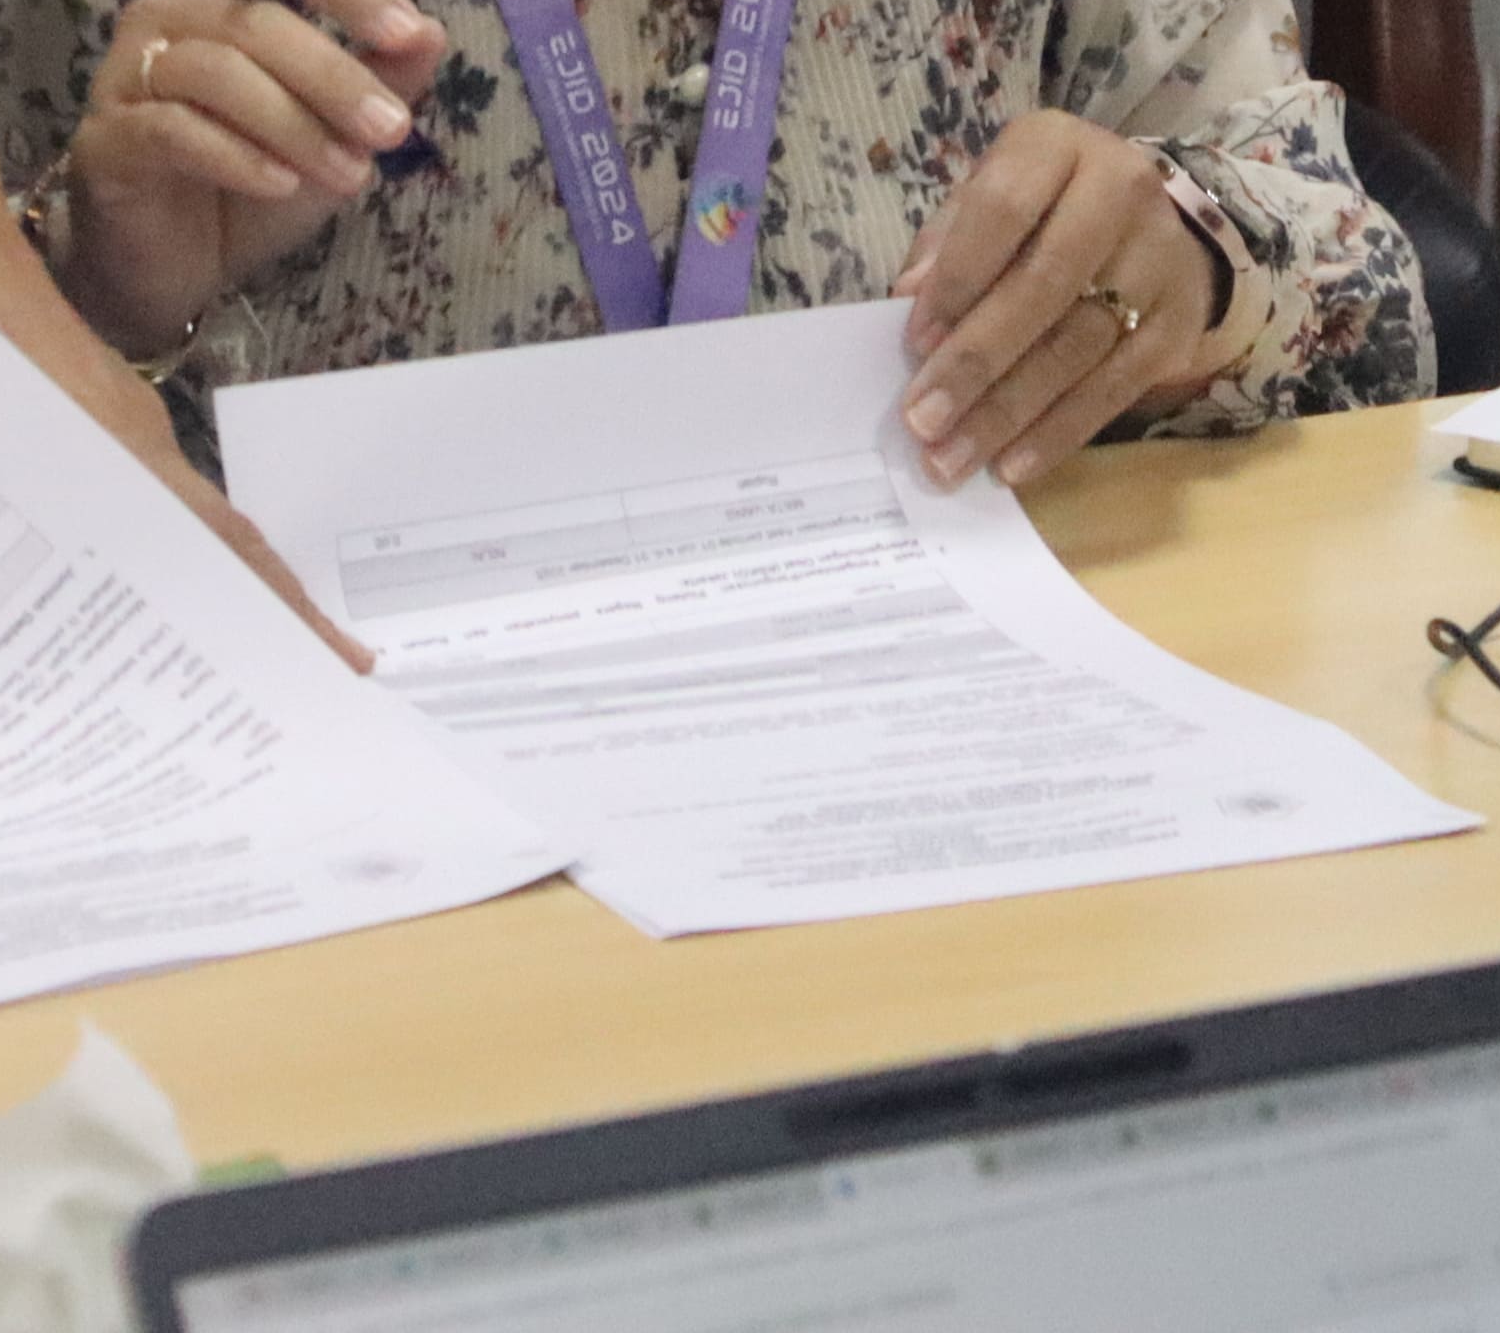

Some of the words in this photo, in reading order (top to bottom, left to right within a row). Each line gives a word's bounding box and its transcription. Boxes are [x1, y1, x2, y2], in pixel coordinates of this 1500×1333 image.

[549, 30, 596, 115] EJID
[580, 131, 636, 246] 2024
[713, 48, 748, 130] EJID
